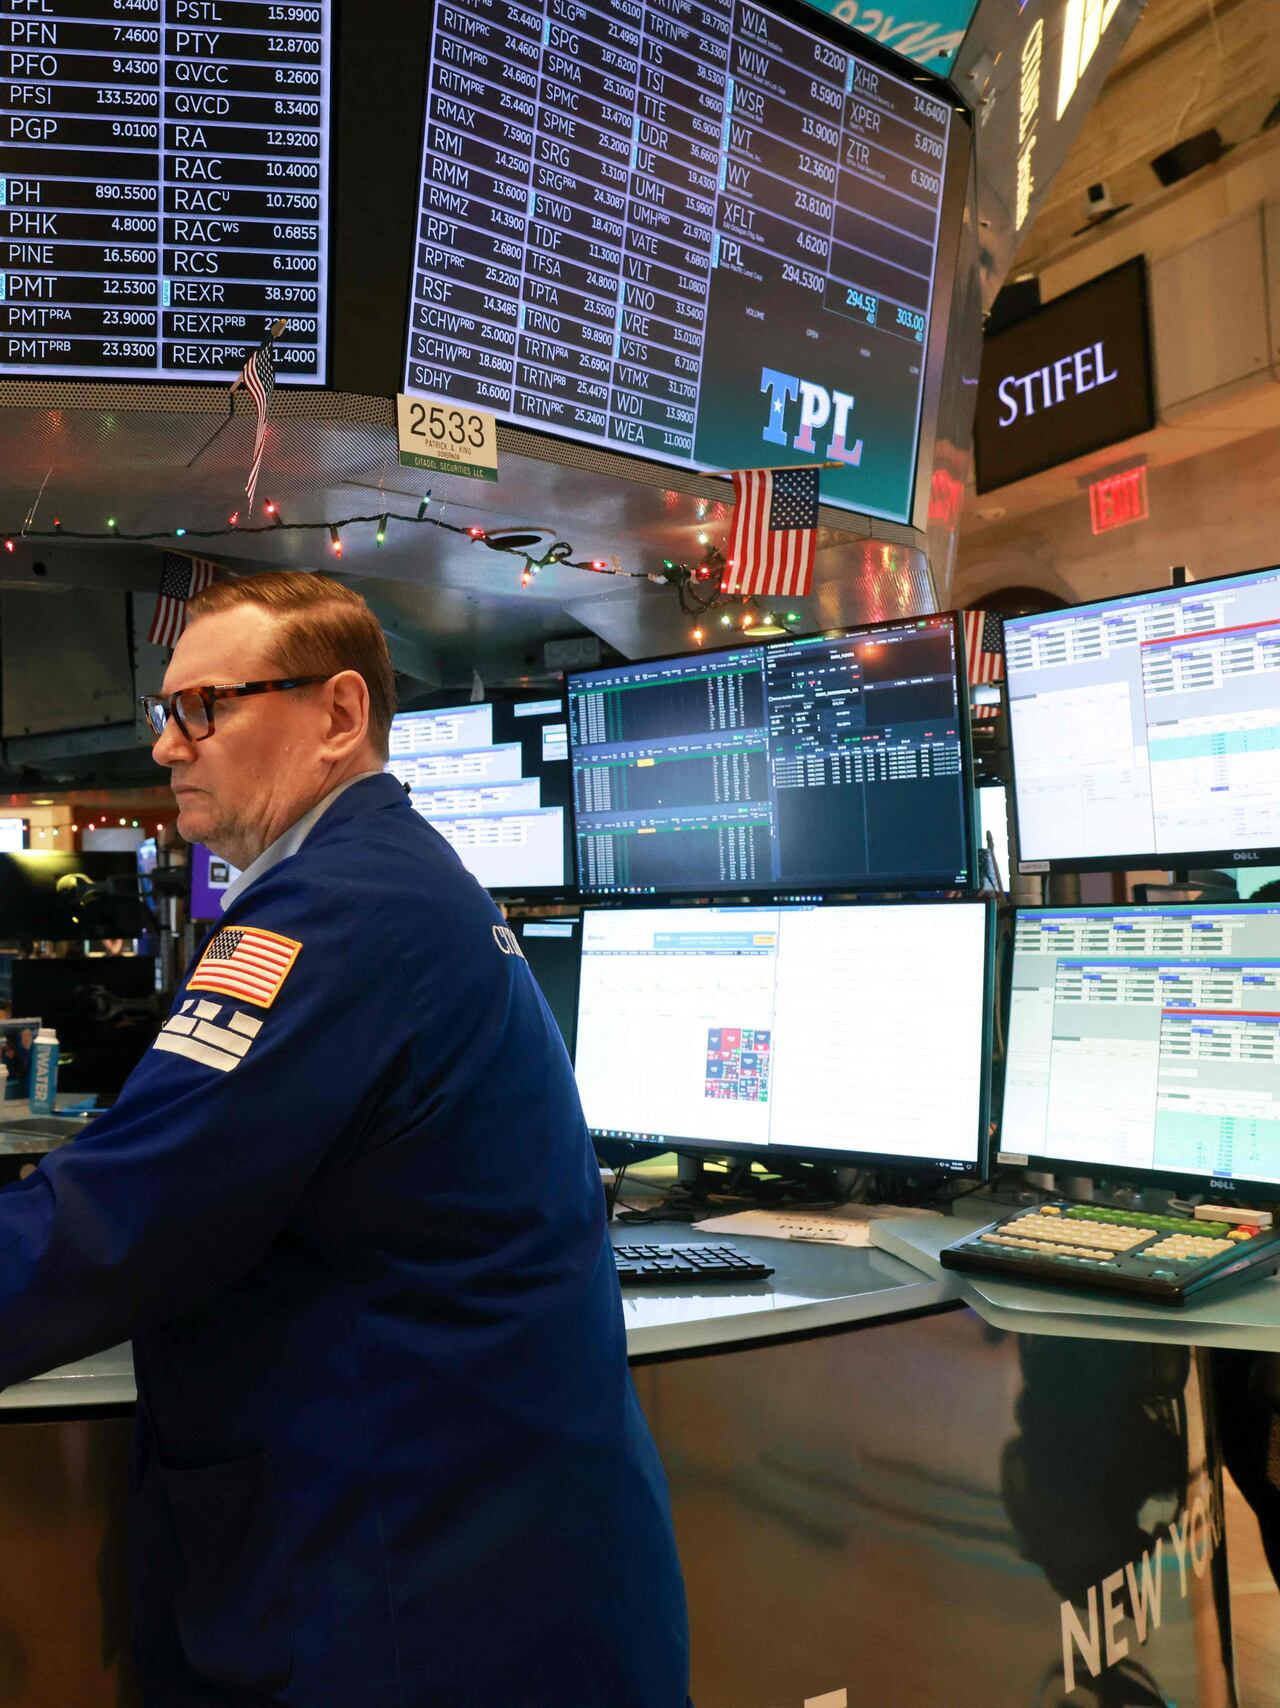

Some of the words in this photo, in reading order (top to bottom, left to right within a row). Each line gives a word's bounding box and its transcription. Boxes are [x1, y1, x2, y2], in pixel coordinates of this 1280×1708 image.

[176, 0, 222, 21] PSTL
[268, 6, 320, 23] 15.9900
[11, 21, 57, 45] PFN
[113, 27, 158, 43] 7.4600
[550, 26, 579, 54] SPG
[601, 49, 637, 74] 187.6200
[10, 85, 51, 105] PFSI
[96, 89, 158, 106] 133.5200
[738, 46, 769, 77] WIW
[810, 82, 842, 110] 8.5900
[175, 94, 230, 115] QVCD
[274, 100, 319, 116] 8.3400
[437, 98, 476, 129] RMAX
[503, 123, 532, 146] 7.5900
[545, 83, 579, 111] SPMC
[601, 106, 632, 129] 13.4700
[735, 84, 765, 116] WSR
[801, 117, 839, 147] 13.9000
[850, 103, 880, 133] XPER
[175, 126, 207, 148] RA
[266, 131, 318, 147] 12.9200
[434, 127, 463, 157] RMI
[495, 151, 529, 174] 14.2500
[640, 122, 669, 151] UDR
[846, 138, 870, 165] ZTR
[540, 139, 570, 167] SRG
[600, 162, 627, 183] 3.3100
[10, 180, 40, 203] PH
[95, 184, 157, 201] 890.5500
[432, 157, 469, 189] RMM
[492, 180, 527, 203] 13.6000
[728, 162, 751, 188] WY
[794, 191, 832, 220] 23.8100
[9, 212, 58, 235] PHK
[111, 217, 157, 232] 4.8000
[429, 187, 469, 217] RMMZ
[490, 209, 525, 231] 14.3900
[536, 196, 572, 223] STWD
[591, 216, 622, 238] 18.4700
[427, 217, 458, 245] RPT
[493, 239, 522, 260] 2.6800
[534, 224, 562, 250] TDF
[589, 244, 620, 265] 11.3000
[174, 251, 219, 274] RCS
[273, 256, 317, 271] 6.1000
[531, 252, 561, 278] TFSA
[586, 271, 618, 292] 24.8000
[629, 257, 652, 282] VLT
[721, 238, 744, 267] TPL
[781, 263, 825, 293] 294.5300
[9, 275, 58, 298] PMT
[103, 279, 156, 295] 12.5300
[173, 282, 224, 302] REXR
[264, 286, 316, 302] 38.9700
[422, 276, 453, 302] RSF
[483, 295, 517, 317] 14.3485
[626, 284, 655, 311] VNO
[675, 301, 704, 321] 33.5400
[527, 308, 560, 334] TRNO
[581, 326, 613, 346] 59.8900
[745, 306, 766, 321] VOLUME
[845, 288, 877, 314] 294.53
[896, 307, 925, 332] 303.00
[865, 312, 876, 325] 40
[415, 366, 452, 391] SDHY
[476, 381, 511, 402] 16.6000
[619, 365, 649, 389] VTMX
[997, 340, 1119, 428] STIFEL
[410, 402, 485, 448] 2533
[614, 418, 644, 444] WEA
[663, 432, 692, 450] 11.0000
[760, 366, 863, 467] TPL
[425, 438, 448, 451] PATRICK
[414, 456, 438, 470] CITADEL
[439, 461, 472, 476] SECURITIES
[473, 468, 485, 478] LLC
[1232, 851, 1260, 861] DELL
[1209, 1179, 1236, 1191] DELL
[1060, 1537, 1163, 1694] NEW
